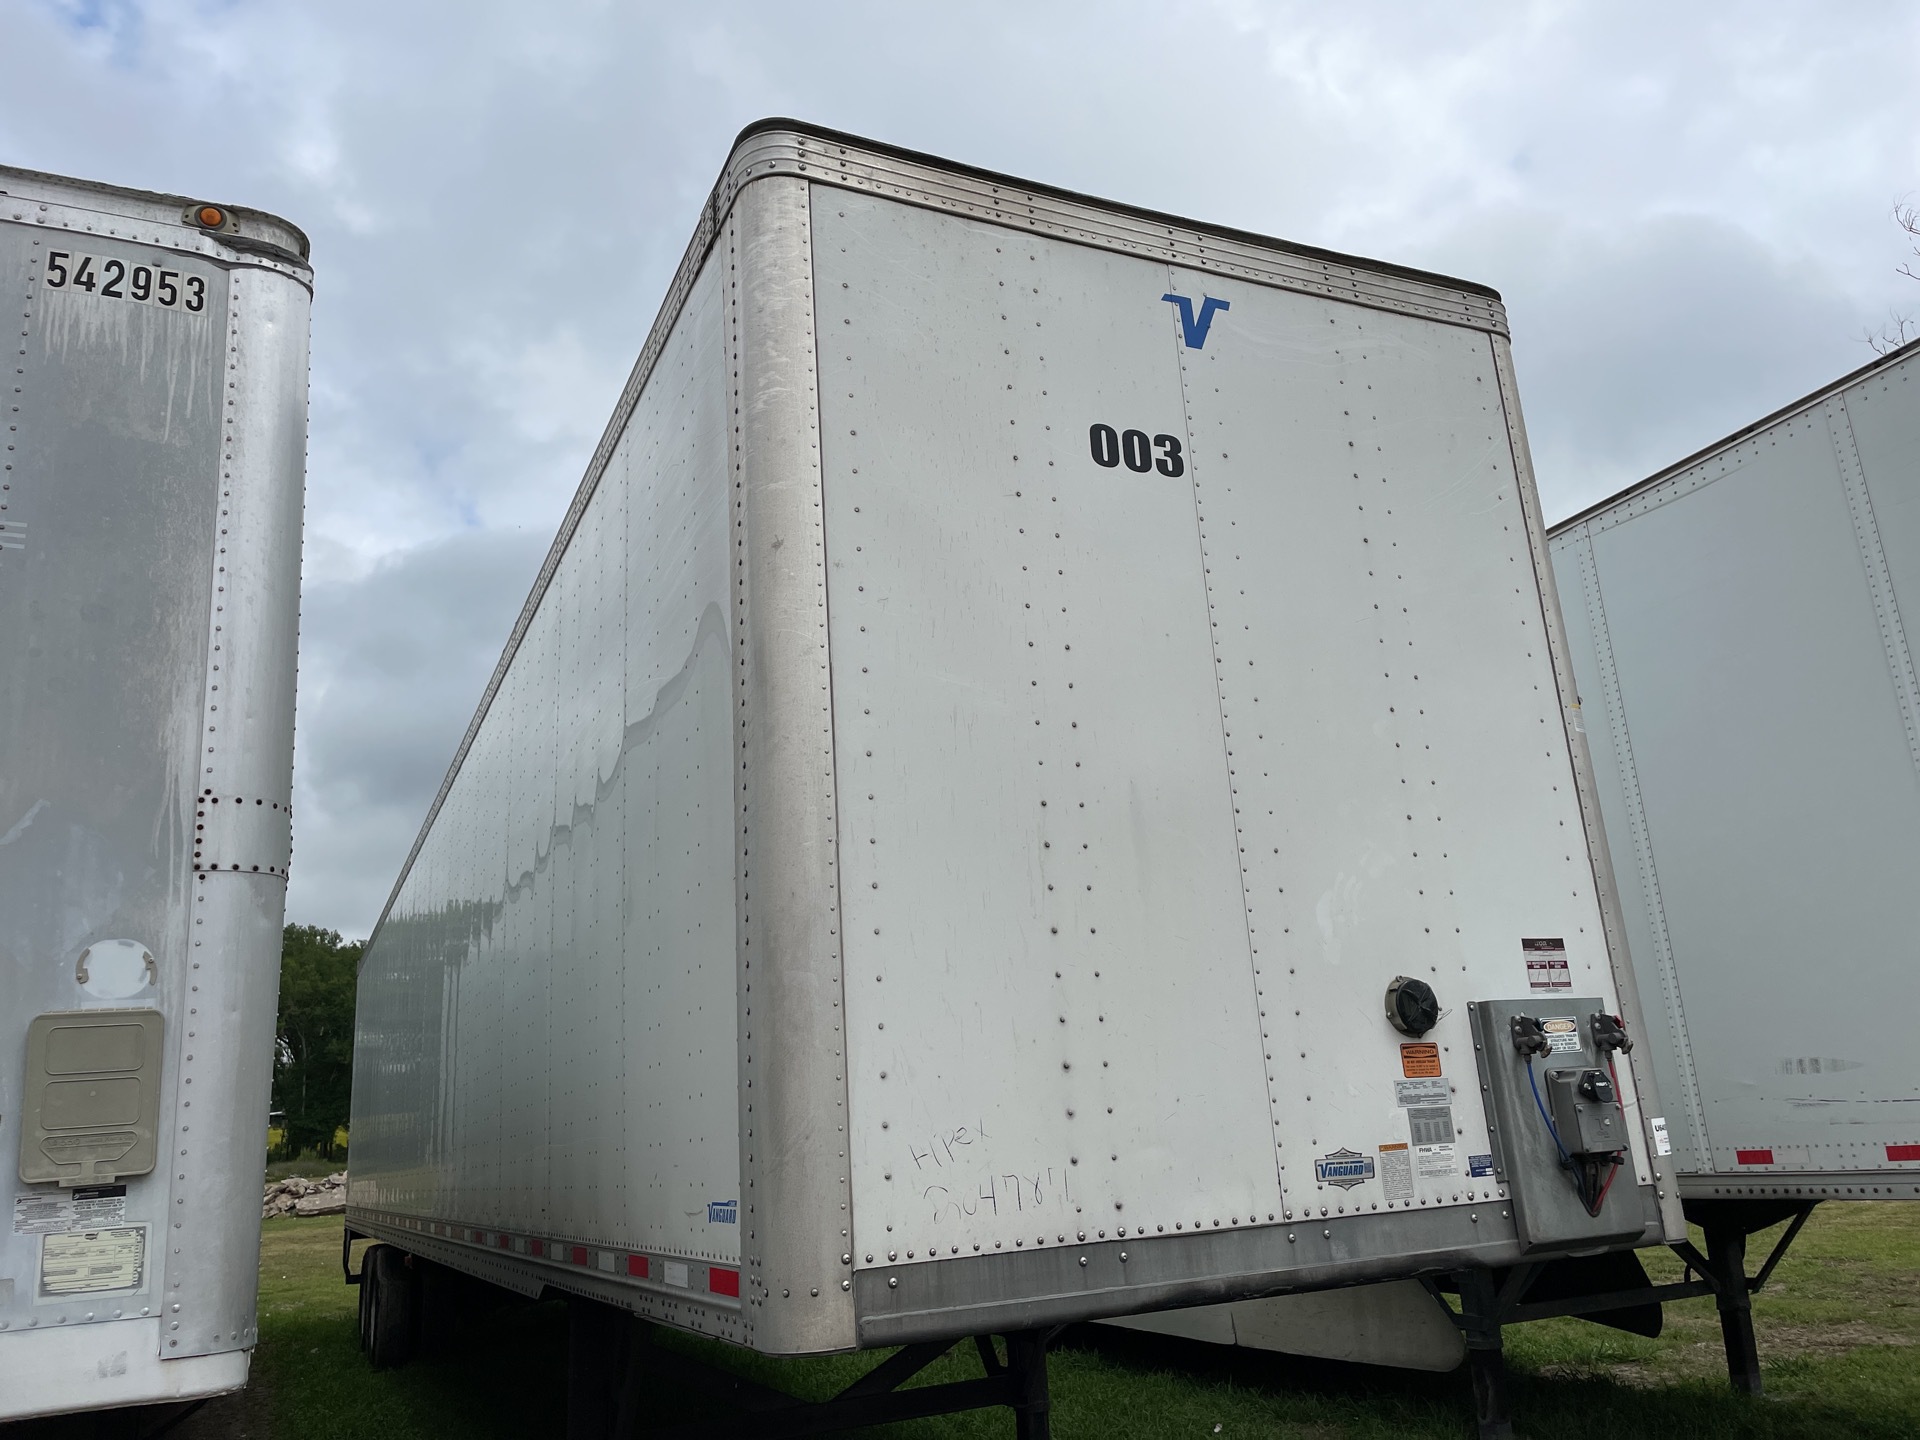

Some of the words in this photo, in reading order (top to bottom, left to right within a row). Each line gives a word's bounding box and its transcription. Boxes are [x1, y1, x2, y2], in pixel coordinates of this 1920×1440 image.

[46, 251, 206, 312] 542953
[1161, 293, 1230, 350] V
[1089, 423, 1185, 478] 003
[1547, 1023, 1572, 1031] DANGER
[1317, 1161, 1364, 1179] VANGUARD
[707, 1202, 737, 1224] VANGUARD
